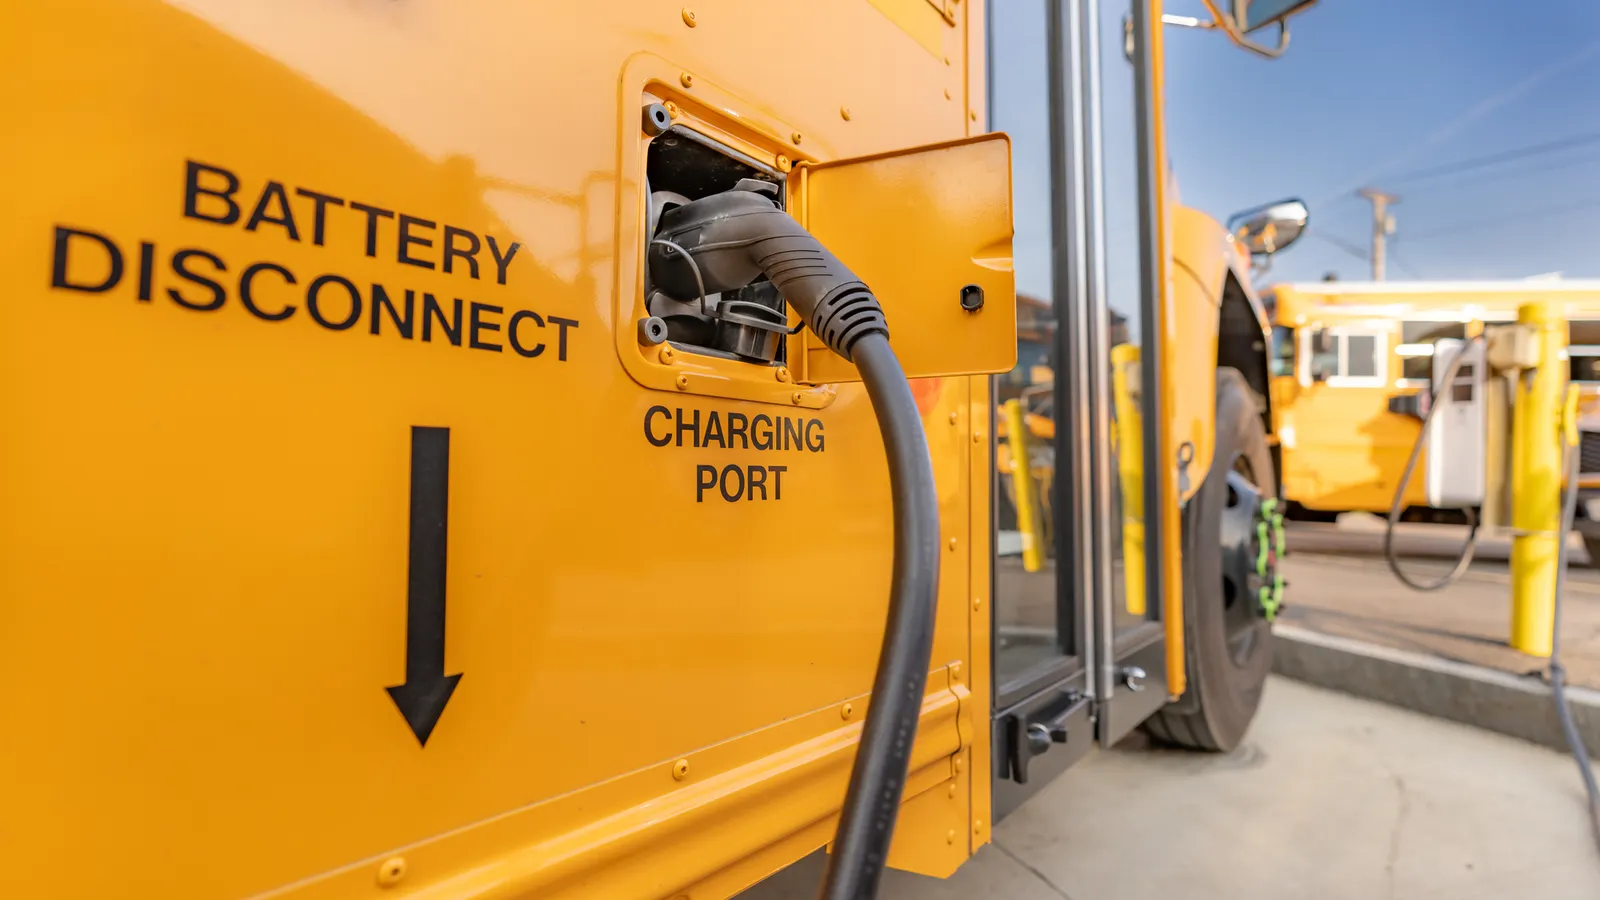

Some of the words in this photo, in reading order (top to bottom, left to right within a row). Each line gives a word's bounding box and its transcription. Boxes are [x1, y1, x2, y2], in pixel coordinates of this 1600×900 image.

[183, 159, 521, 286] BATTERY
[50, 225, 580, 362] DISCONNECT
[643, 405, 825, 453] CHARGING
[696, 463, 788, 503] PORT
